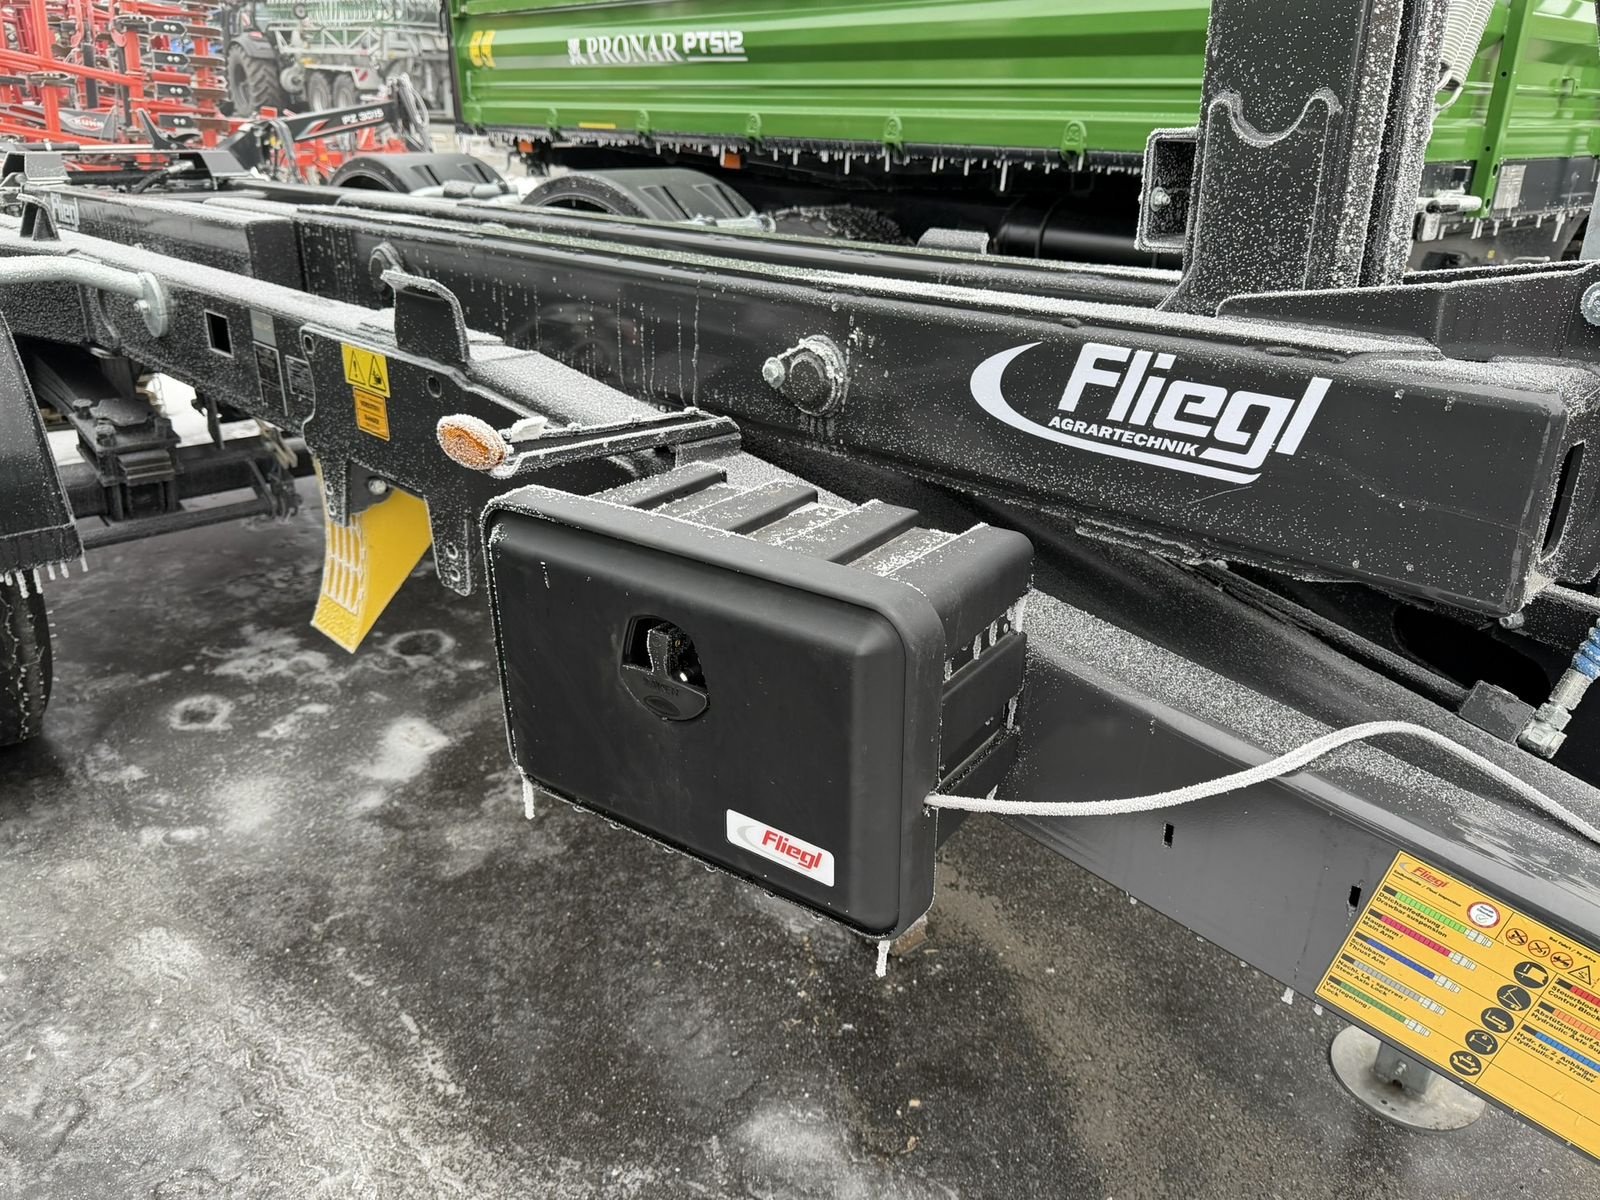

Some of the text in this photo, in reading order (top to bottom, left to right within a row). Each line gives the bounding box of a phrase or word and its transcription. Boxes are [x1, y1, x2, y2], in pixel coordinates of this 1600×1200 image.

[586, 31, 745, 64] PRONAR PT512
[1057, 342, 1333, 469] Fliegl
[1048, 415, 1200, 458] AGRARTECHNIK
[761, 829, 823, 870] Fliegl
[1412, 866, 1449, 888] Fliegl
[1365, 915, 1399, 938] Hauptarm
[1376, 897, 1447, 938] Drawbar suspension
[1379, 892, 1441, 929] Deichselfederung
[1362, 920, 1395, 940] Main Arm
[1348, 942, 1386, 966] Thrust Arm
[1351, 938, 1386, 959] Schubarm
[1322, 985, 1339, 997] Lock
[1325, 981, 1368, 1009] Verriegelung
[1335, 964, 1388, 997] Steer Axle Lock
[1361, 973, 1370, 981] LA
[1375, 982, 1403, 1000] sperren
[1548, 990, 1600, 1022] Control Block
[1551, 985, 1599, 1014] Steuerblock
[1531, 1012, 1568, 1036] Hydraulic
[1569, 1034, 1588, 1046] Axle
[1534, 1008, 1578, 1035] Abstützung
[1579, 1033, 1593, 1042] auf
[1514, 1036, 1554, 1061] Hydraulics
[1568, 1067, 1595, 1083] Trailer
[1516, 1031, 1536, 1046] Hydr.
[1538, 1043, 1550, 1052] für
[1560, 1055, 1598, 1079] Anhänger
